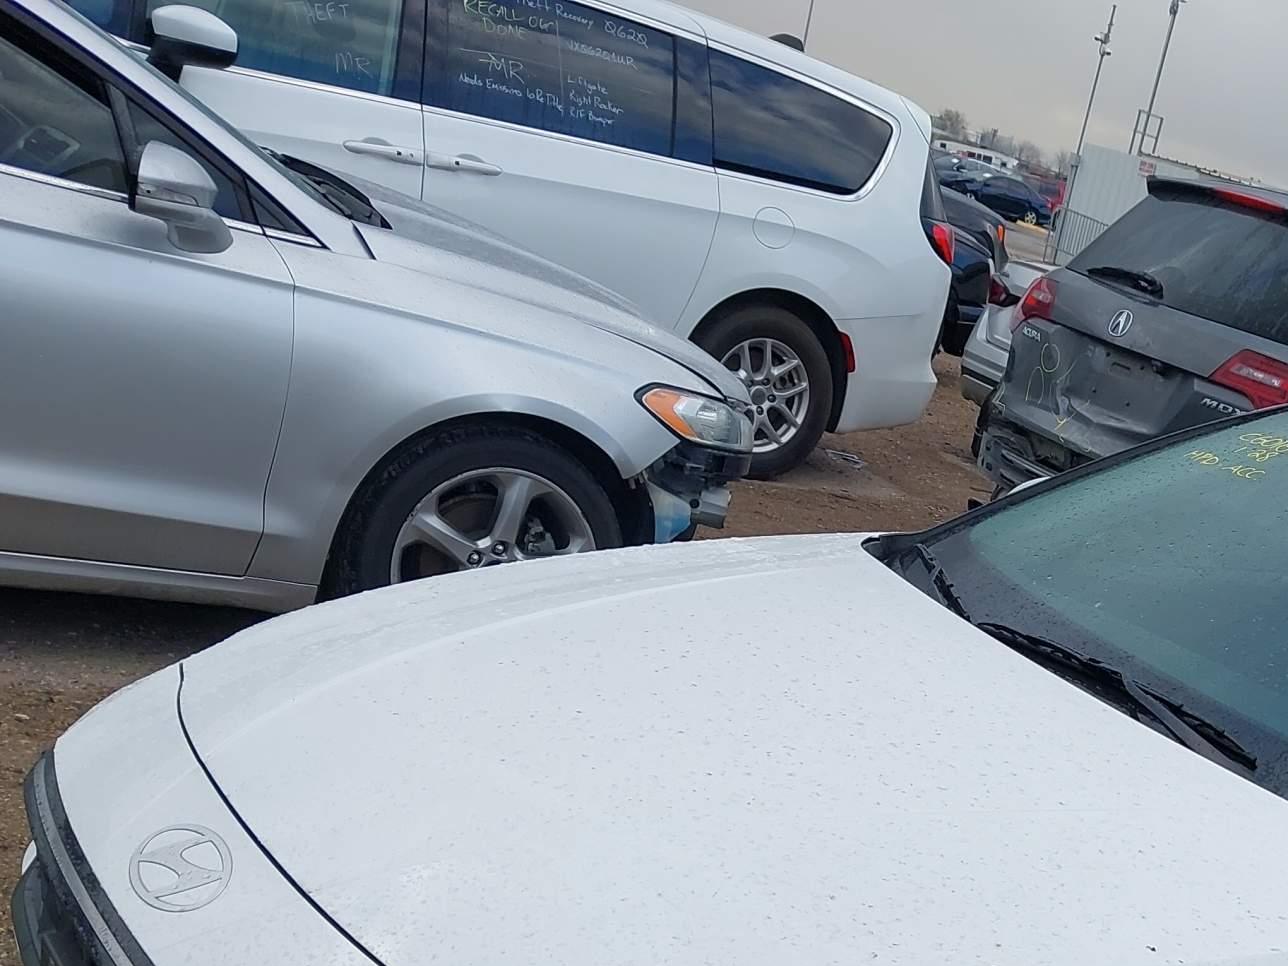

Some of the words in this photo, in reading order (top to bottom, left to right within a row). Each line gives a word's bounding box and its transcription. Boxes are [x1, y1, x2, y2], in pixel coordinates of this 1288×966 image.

[284, 1, 349, 24] THEFT
[482, 17, 528, 39] DONE
[1022, 326, 1041, 342] ACURA
